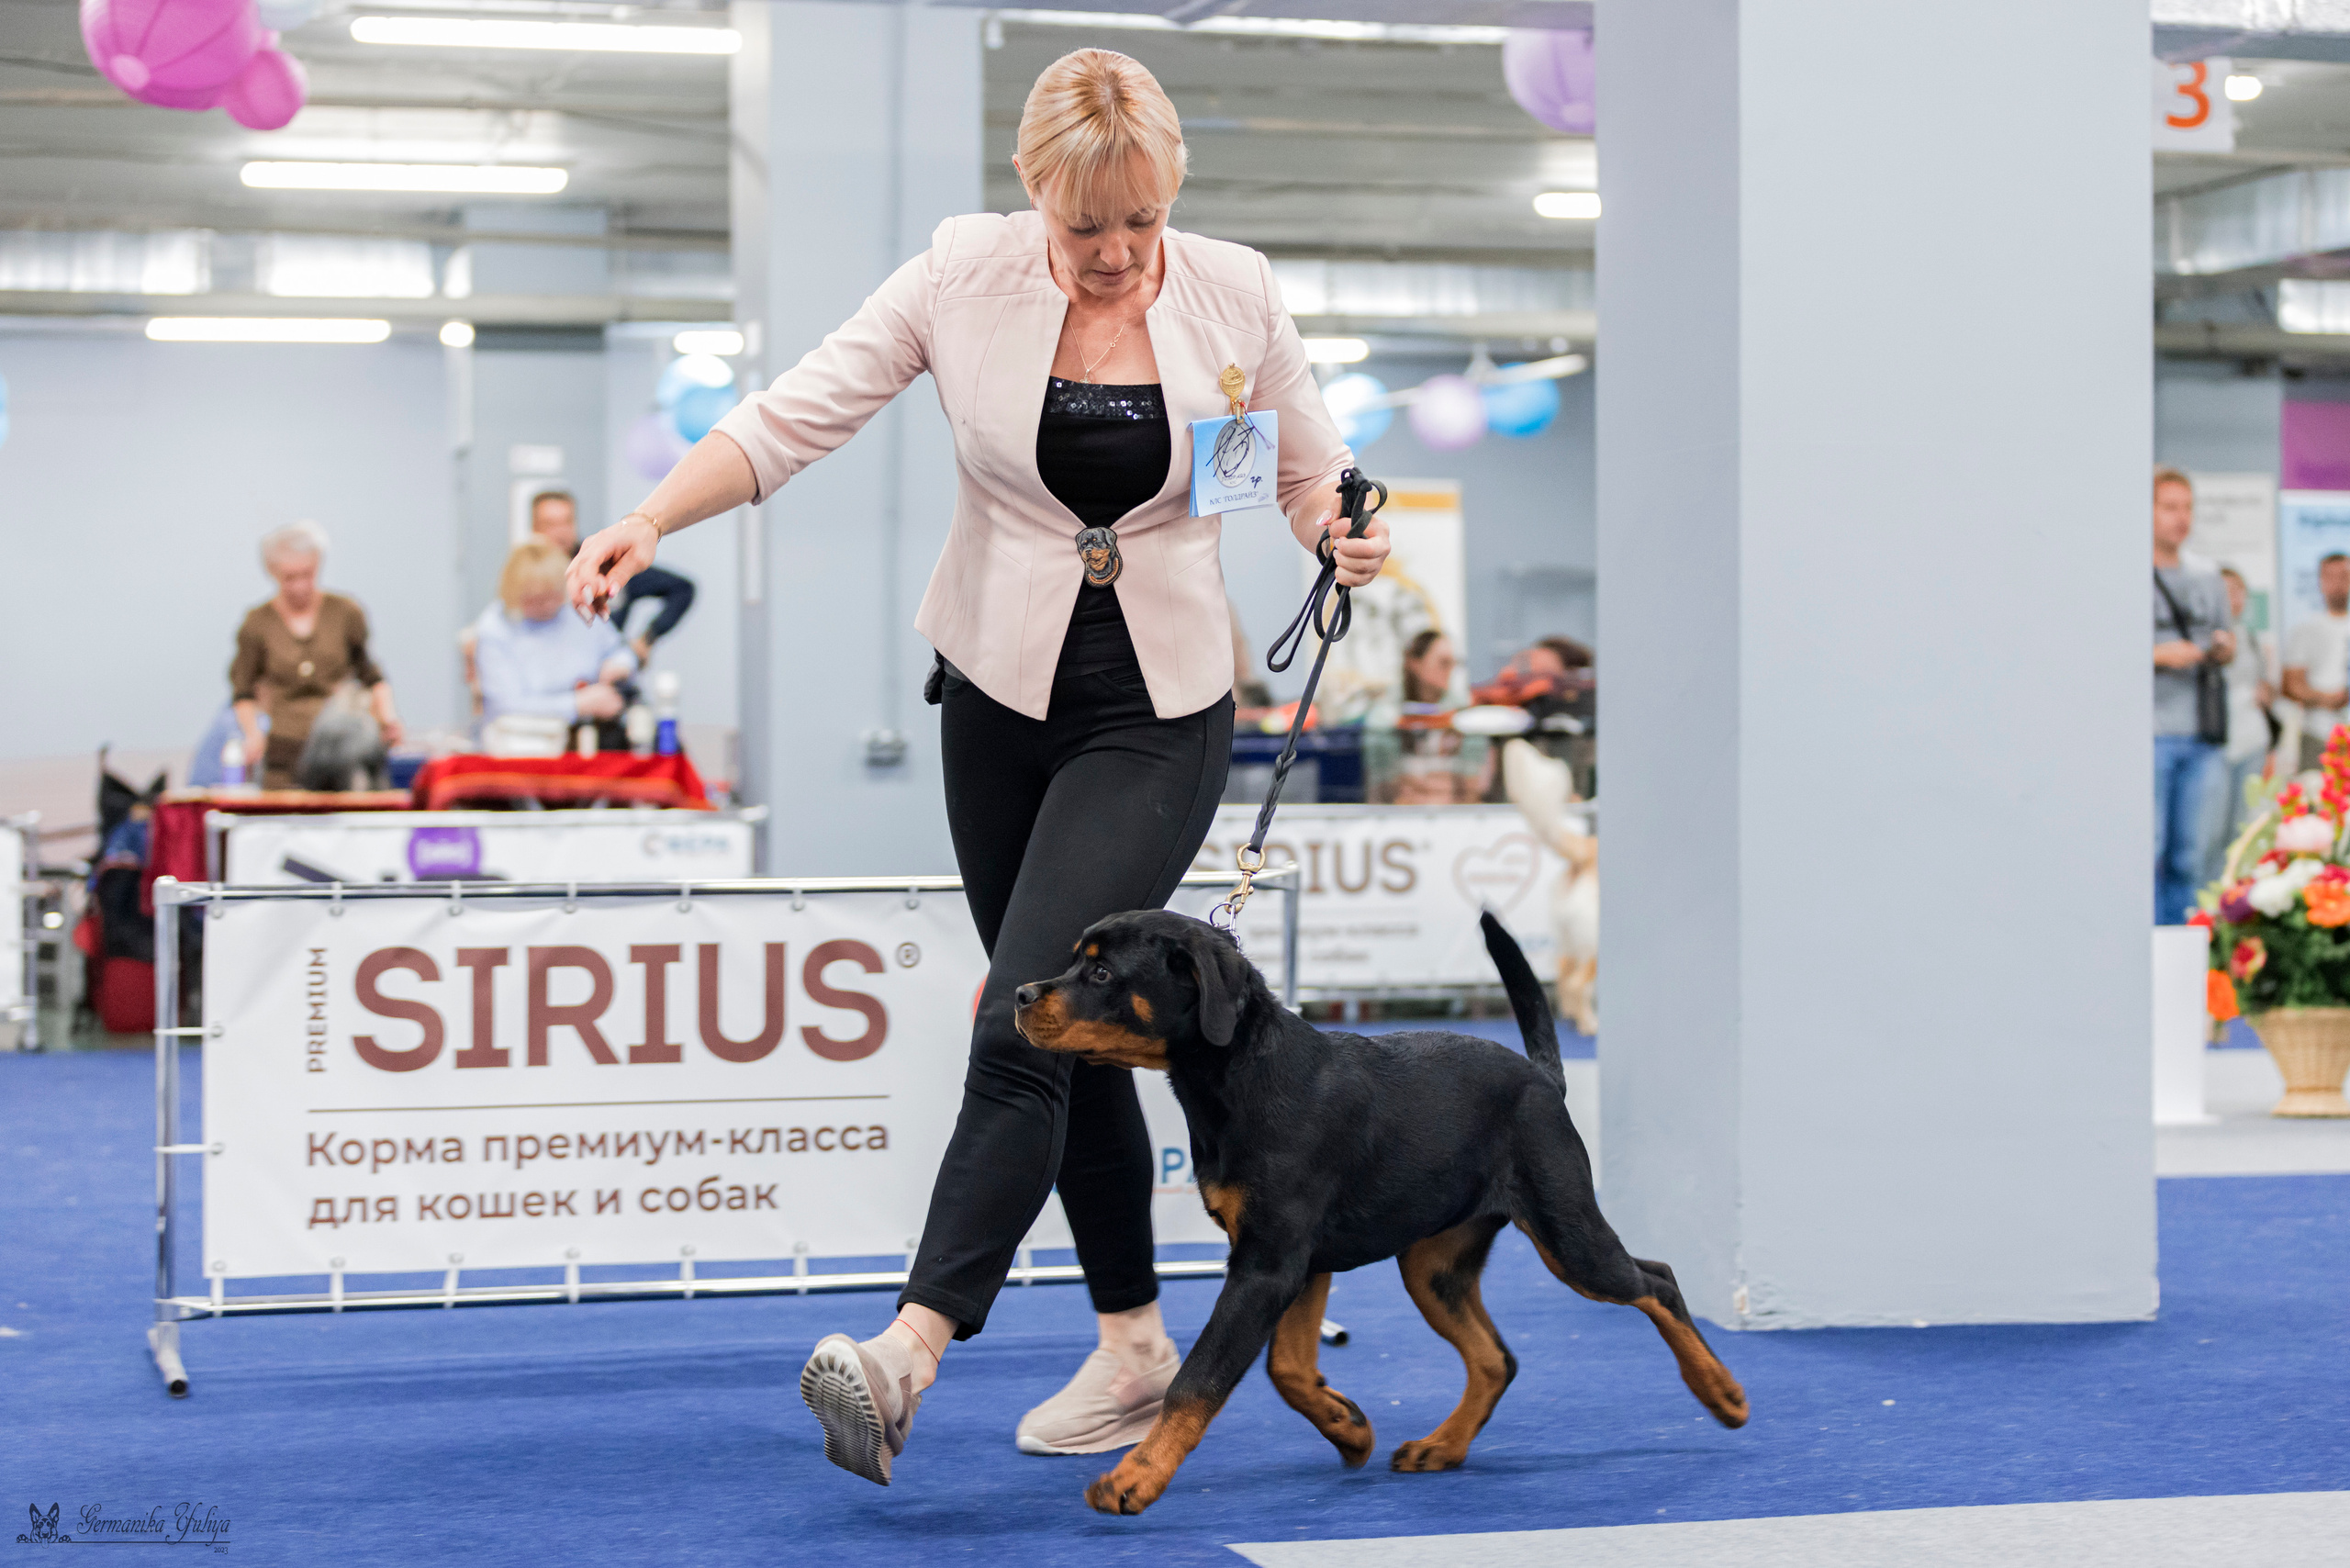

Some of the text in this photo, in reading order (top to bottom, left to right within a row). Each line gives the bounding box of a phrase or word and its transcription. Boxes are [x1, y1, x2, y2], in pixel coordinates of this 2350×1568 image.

[2165, 61, 2210, 129] 3
[308, 947, 328, 1073] PREMIUM
[307, 1123, 889, 1174] Корма премиум-класса
[308, 1174, 779, 1229] для кошек и собак
